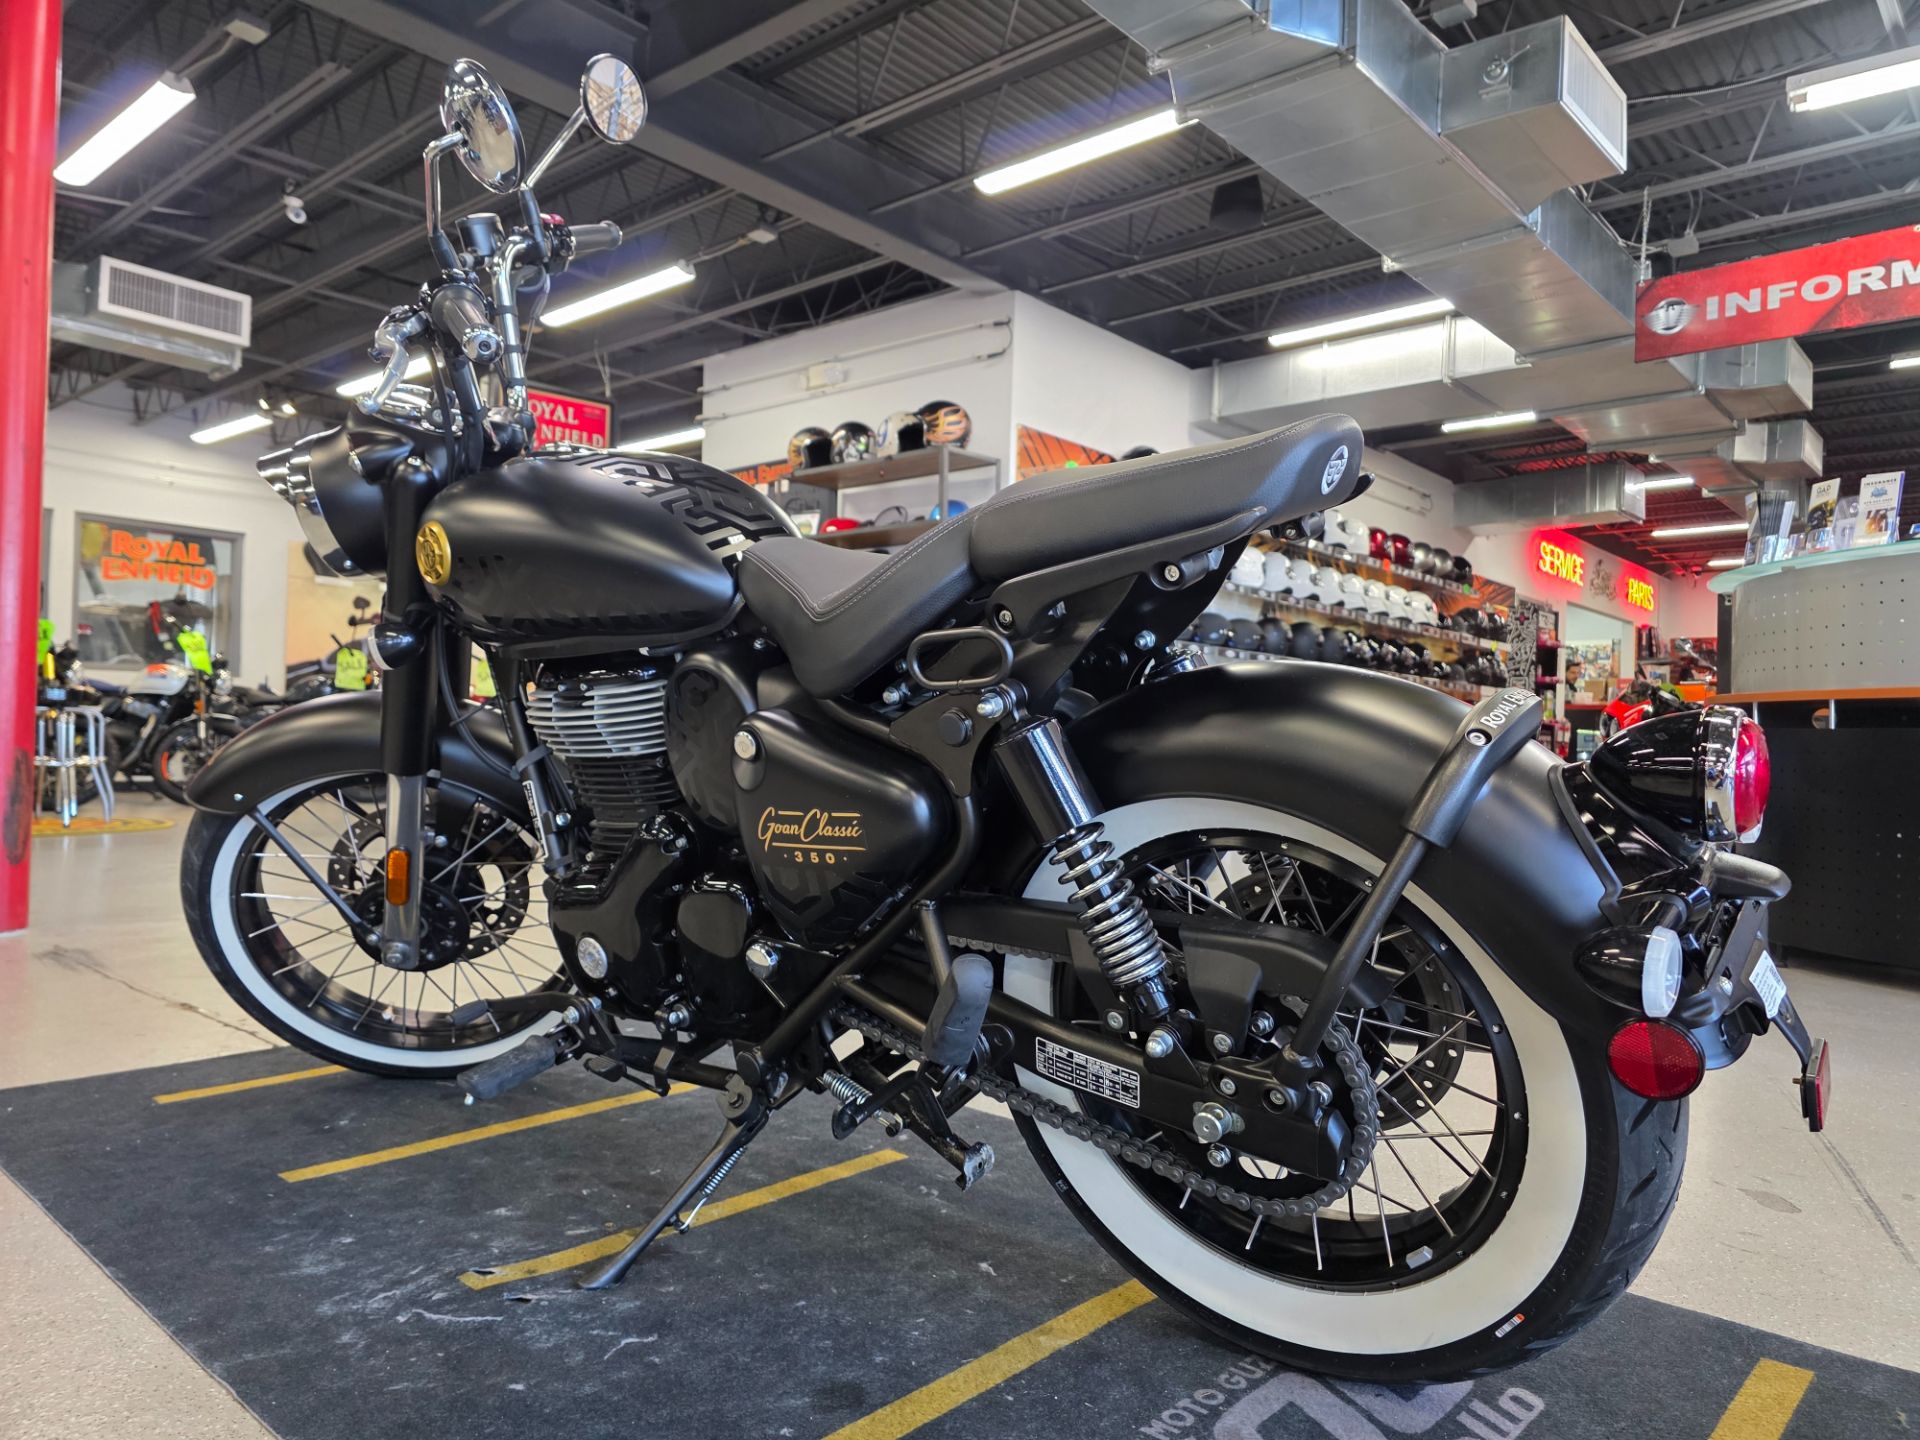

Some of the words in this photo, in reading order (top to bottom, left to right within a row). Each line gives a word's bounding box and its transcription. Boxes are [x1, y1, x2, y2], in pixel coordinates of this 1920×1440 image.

[1706, 259, 1920, 320] INFORM
[528, 400, 579, 425] OYAL
[533, 424, 604, 448] NFIELD
[111, 529, 206, 565] ROYAL
[1539, 541, 1584, 587] SERVICE
[101, 555, 217, 591] ENFIELD
[1627, 578, 1654, 611] PARTS
[1480, 700, 1517, 729] ROYAL
[758, 806, 803, 853] Goan
[800, 808, 862, 842] Classic
[794, 851, 835, 864] 350
[1138, 1388, 1225, 1440] MOTO
[1217, 1354, 1280, 1390] GUZ
